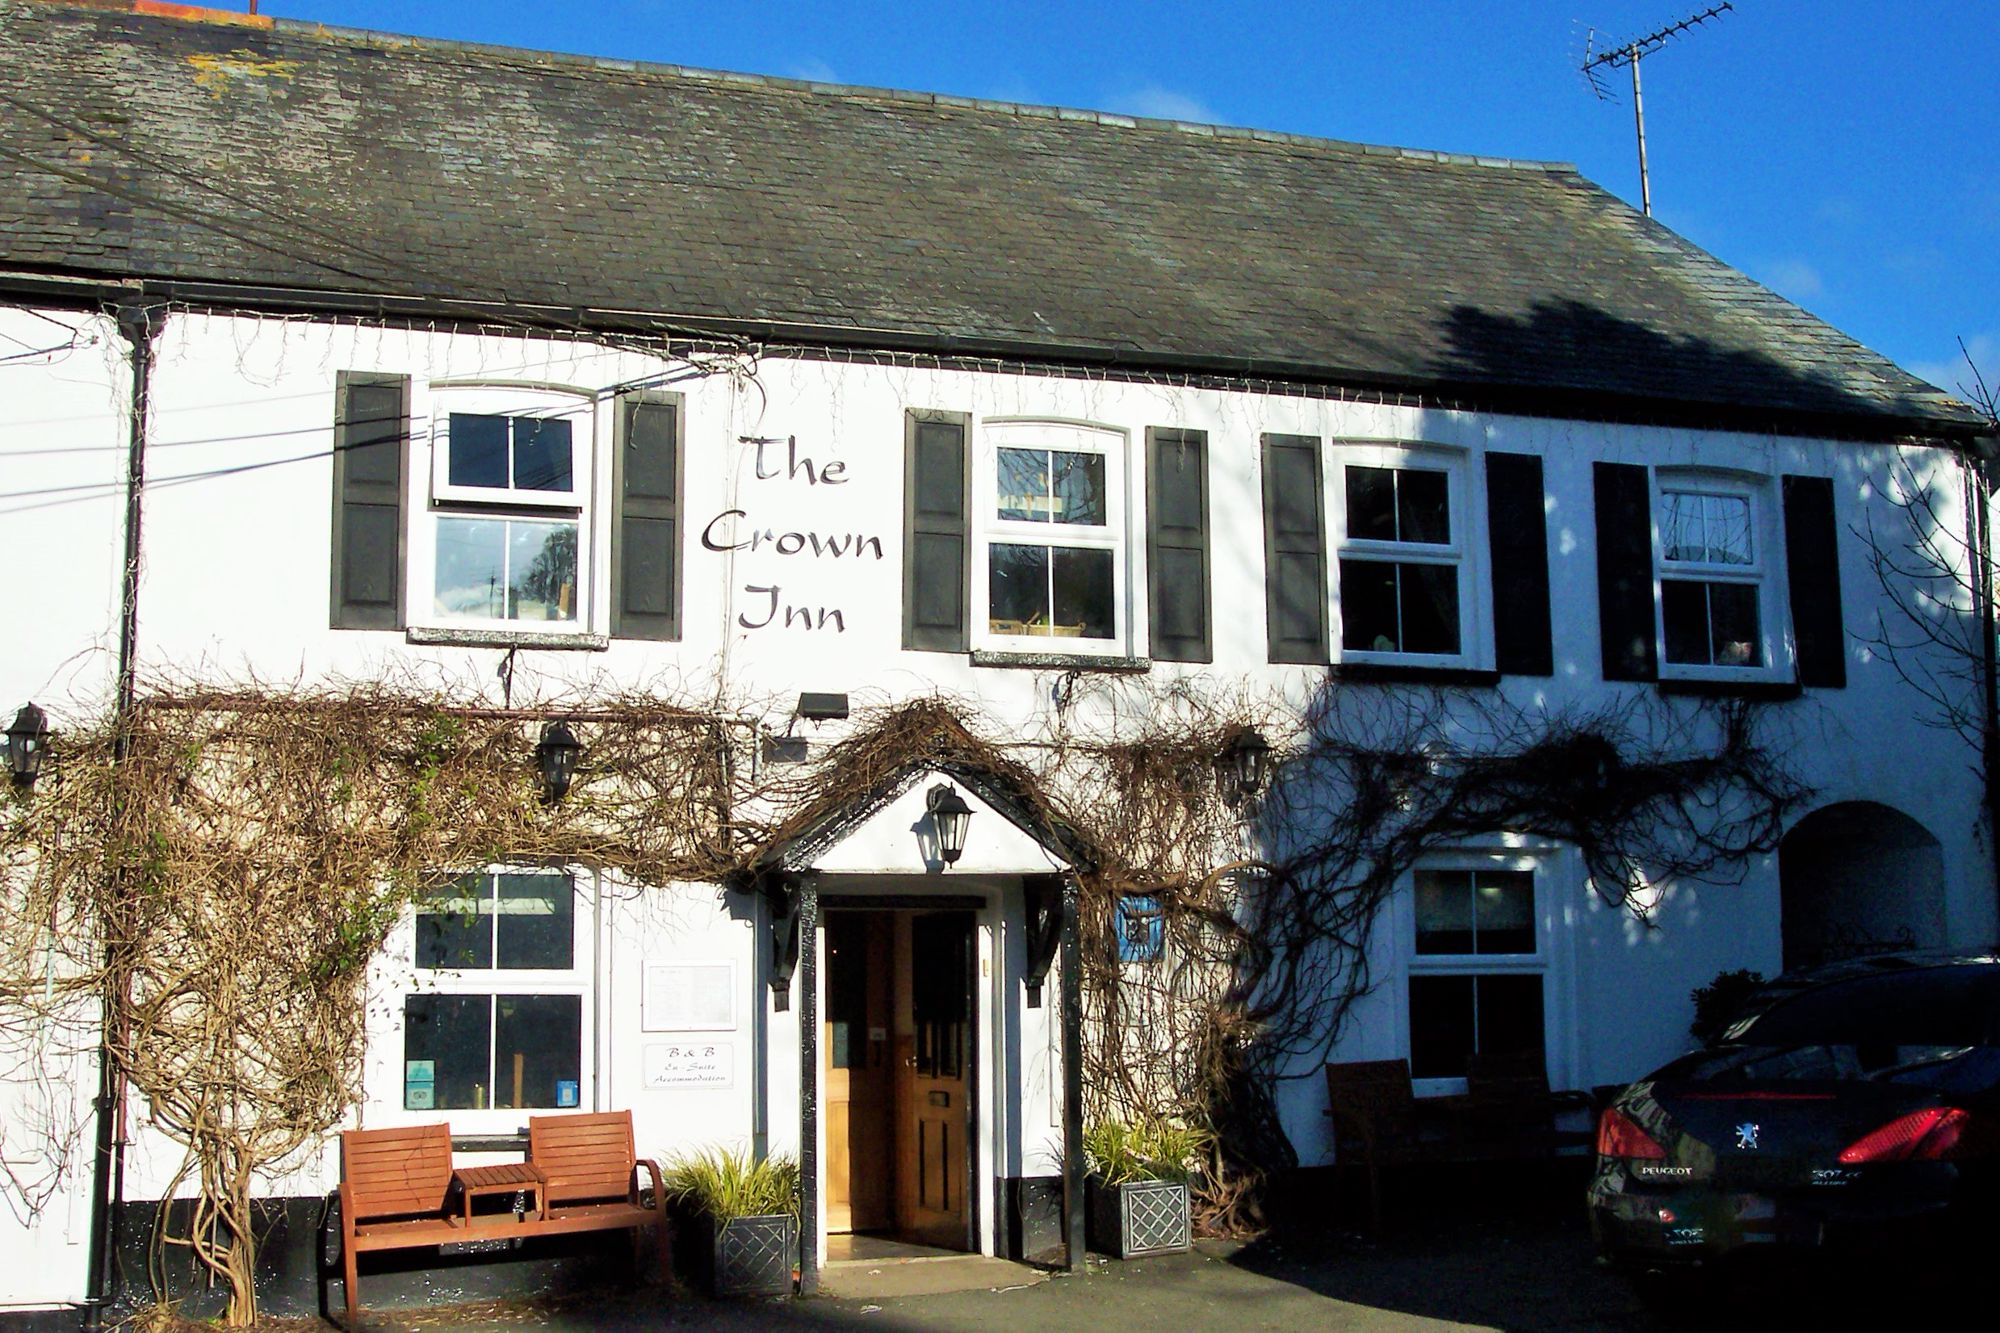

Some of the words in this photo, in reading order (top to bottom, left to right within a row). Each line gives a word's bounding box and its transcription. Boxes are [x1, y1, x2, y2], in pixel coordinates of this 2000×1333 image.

[738, 435, 849, 485] The
[701, 509, 883, 560] Crown
[666, 1047, 680, 1057] B
[683, 1049, 695, 1057] &
[702, 1046, 715, 1057] B
[1642, 1167, 1693, 1176] PEUGEOT
